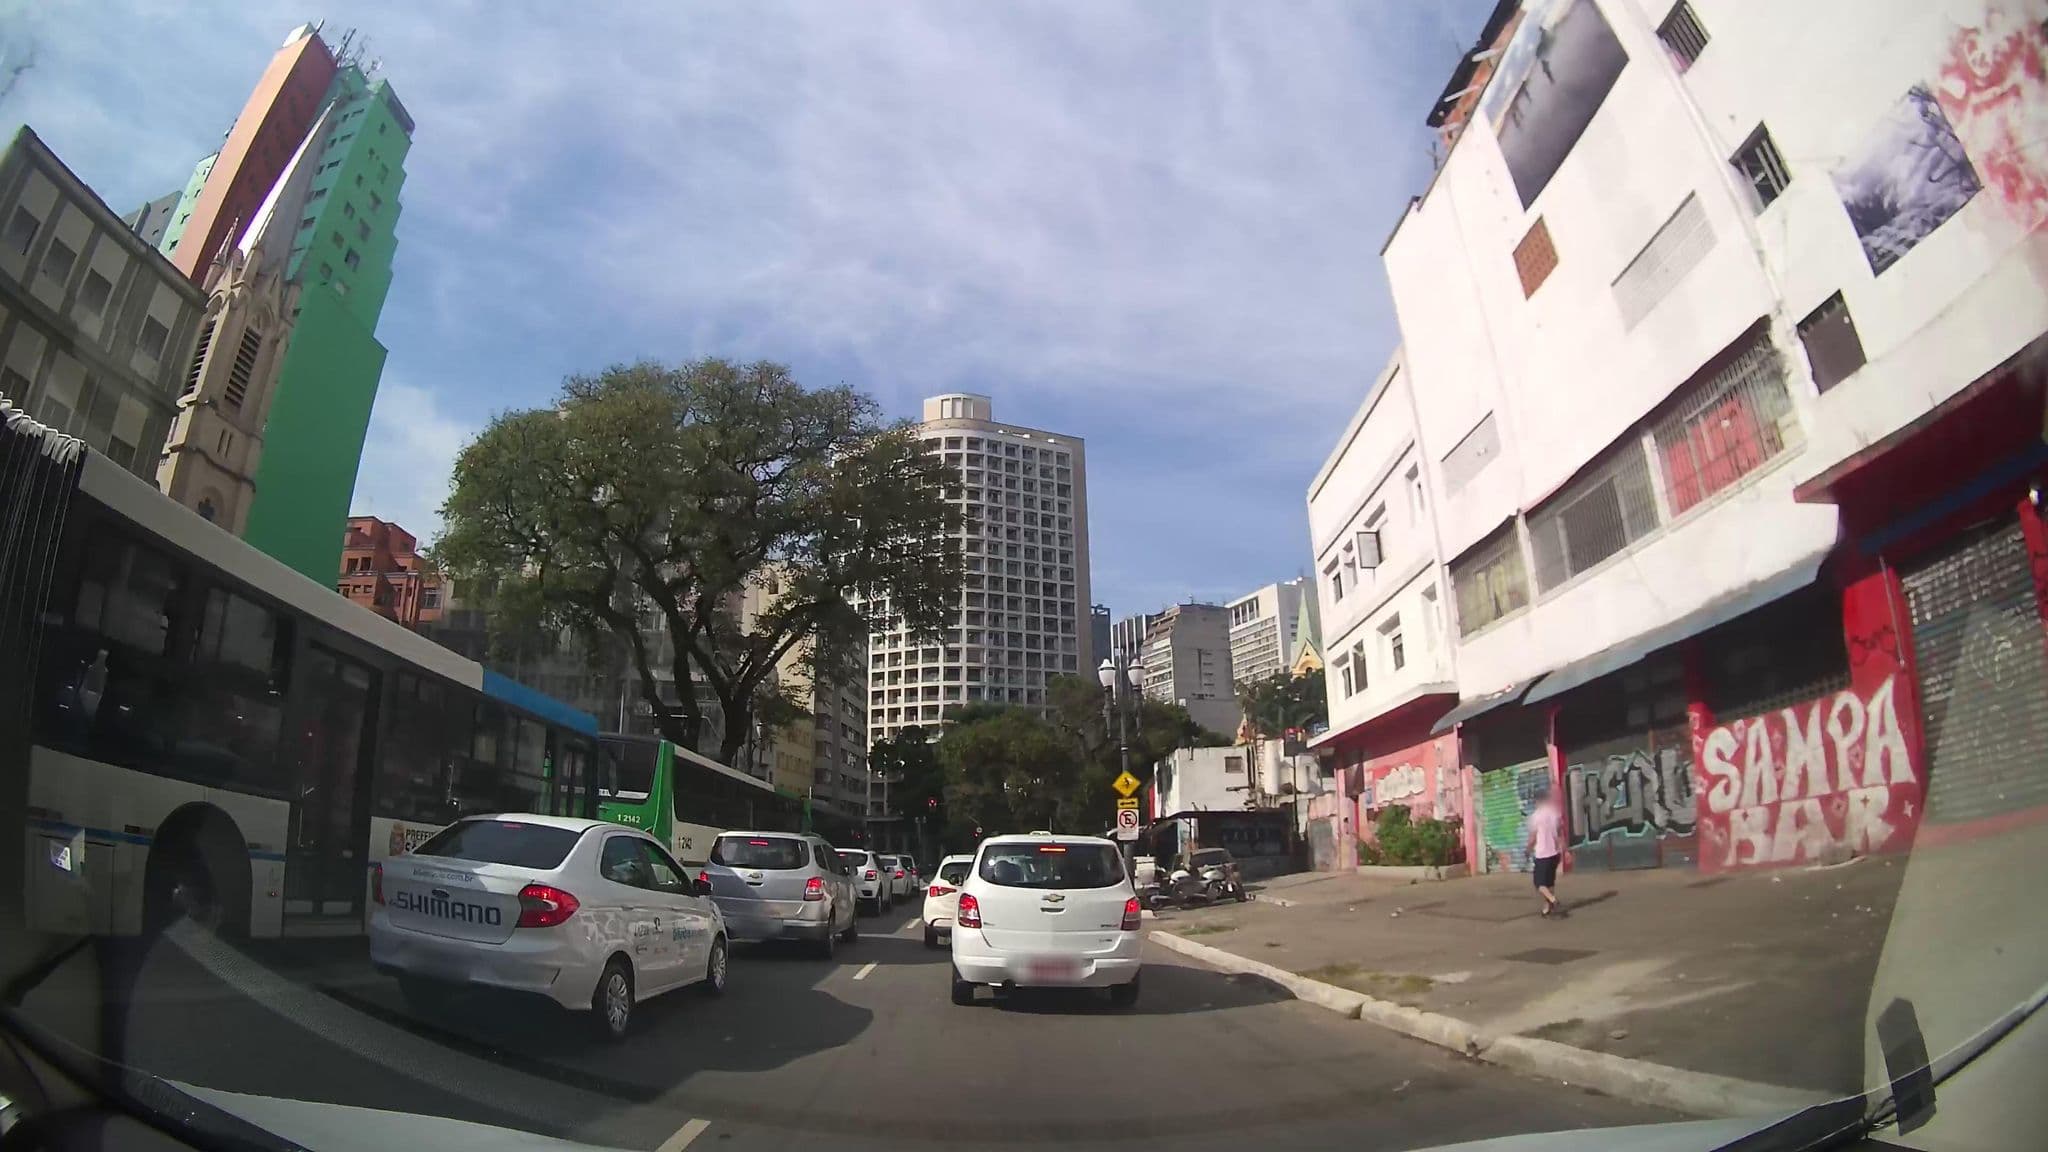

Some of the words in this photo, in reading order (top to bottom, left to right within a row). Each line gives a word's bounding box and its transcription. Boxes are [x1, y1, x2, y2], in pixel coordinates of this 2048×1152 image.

[1702, 675, 1917, 814] SAMPA
[623, 814, 641, 824] 2142
[1723, 785, 1896, 866] BAR
[396, 890, 501, 926] SHIMANO
